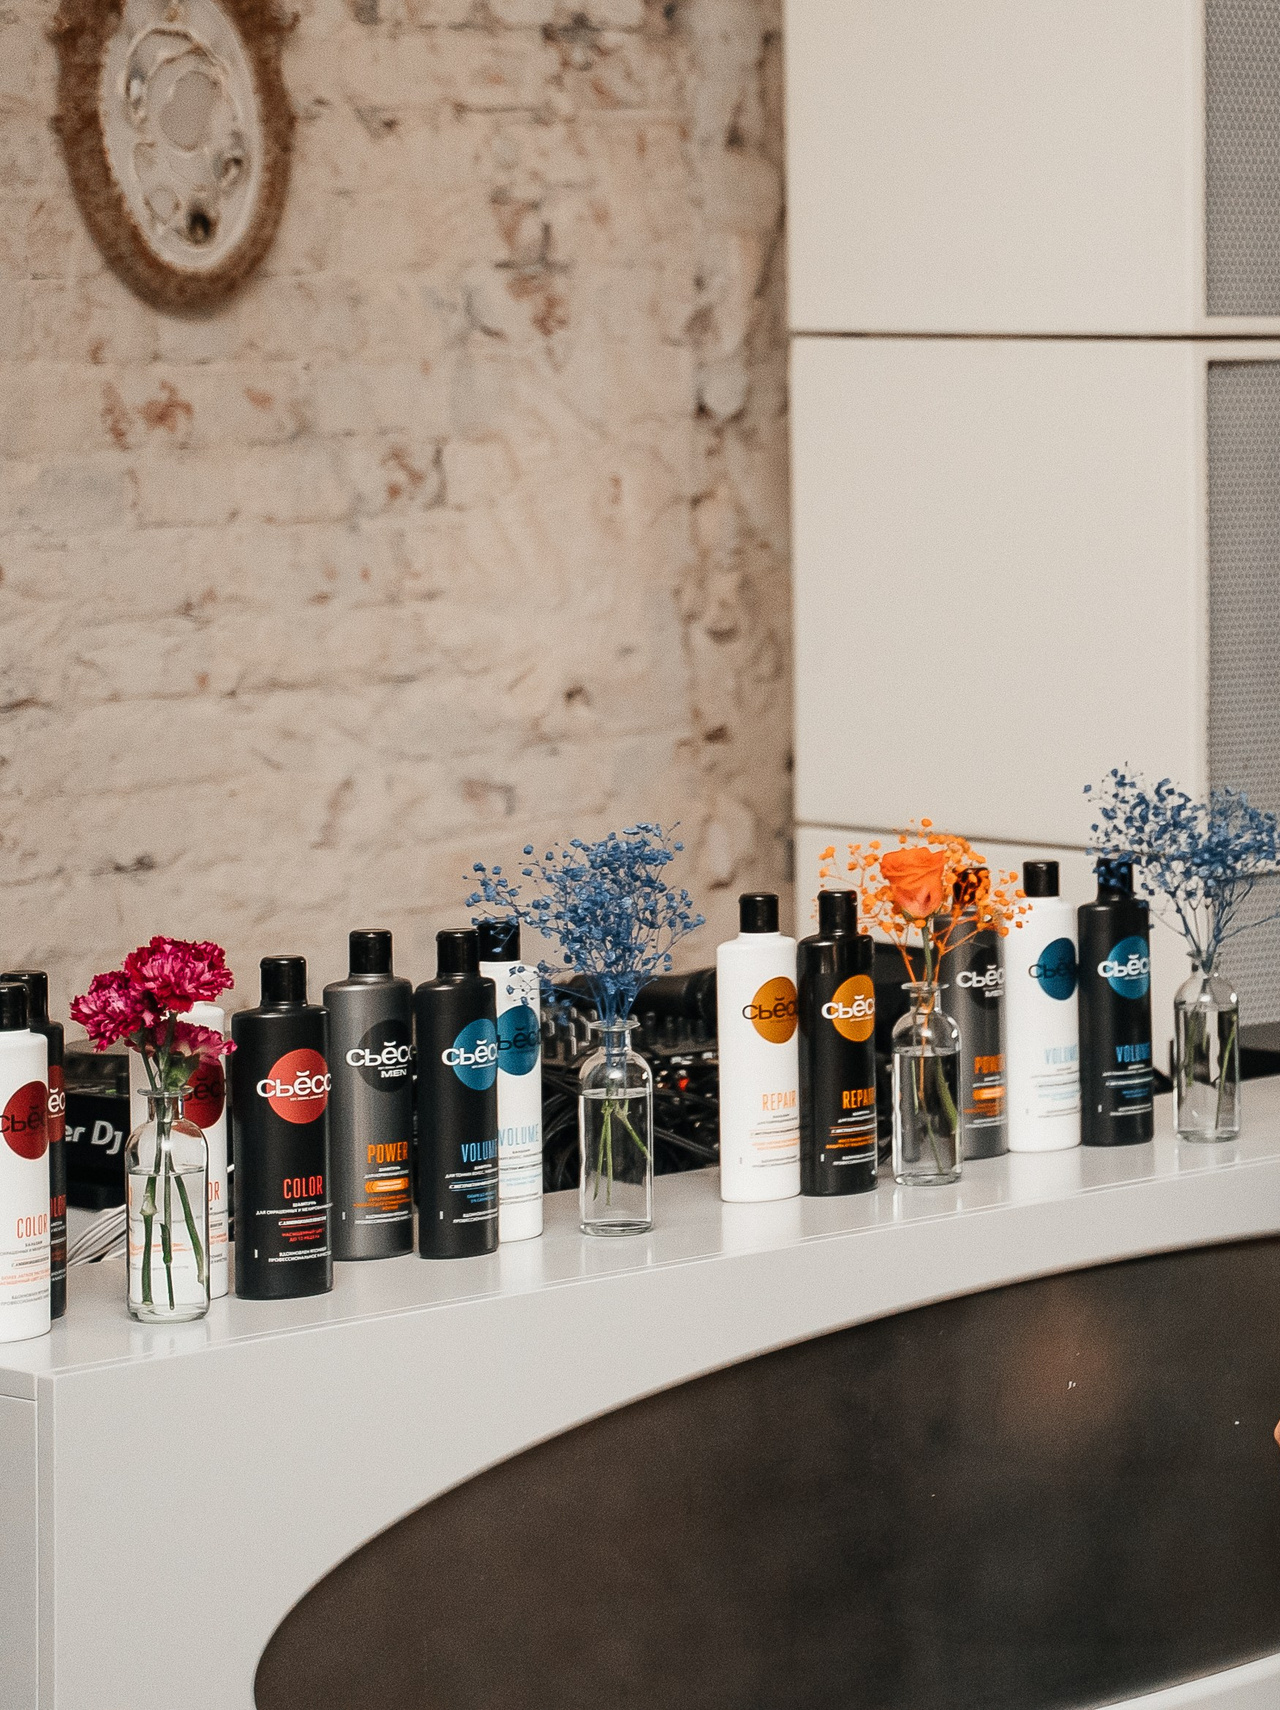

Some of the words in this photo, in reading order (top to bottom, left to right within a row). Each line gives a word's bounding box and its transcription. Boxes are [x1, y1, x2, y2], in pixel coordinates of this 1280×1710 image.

[380, 1069, 407, 1078] MEN
[367, 1141, 408, 1164] POWER
[283, 1175, 323, 1199] COLOR
[17, 1213, 48, 1239] COLOR
